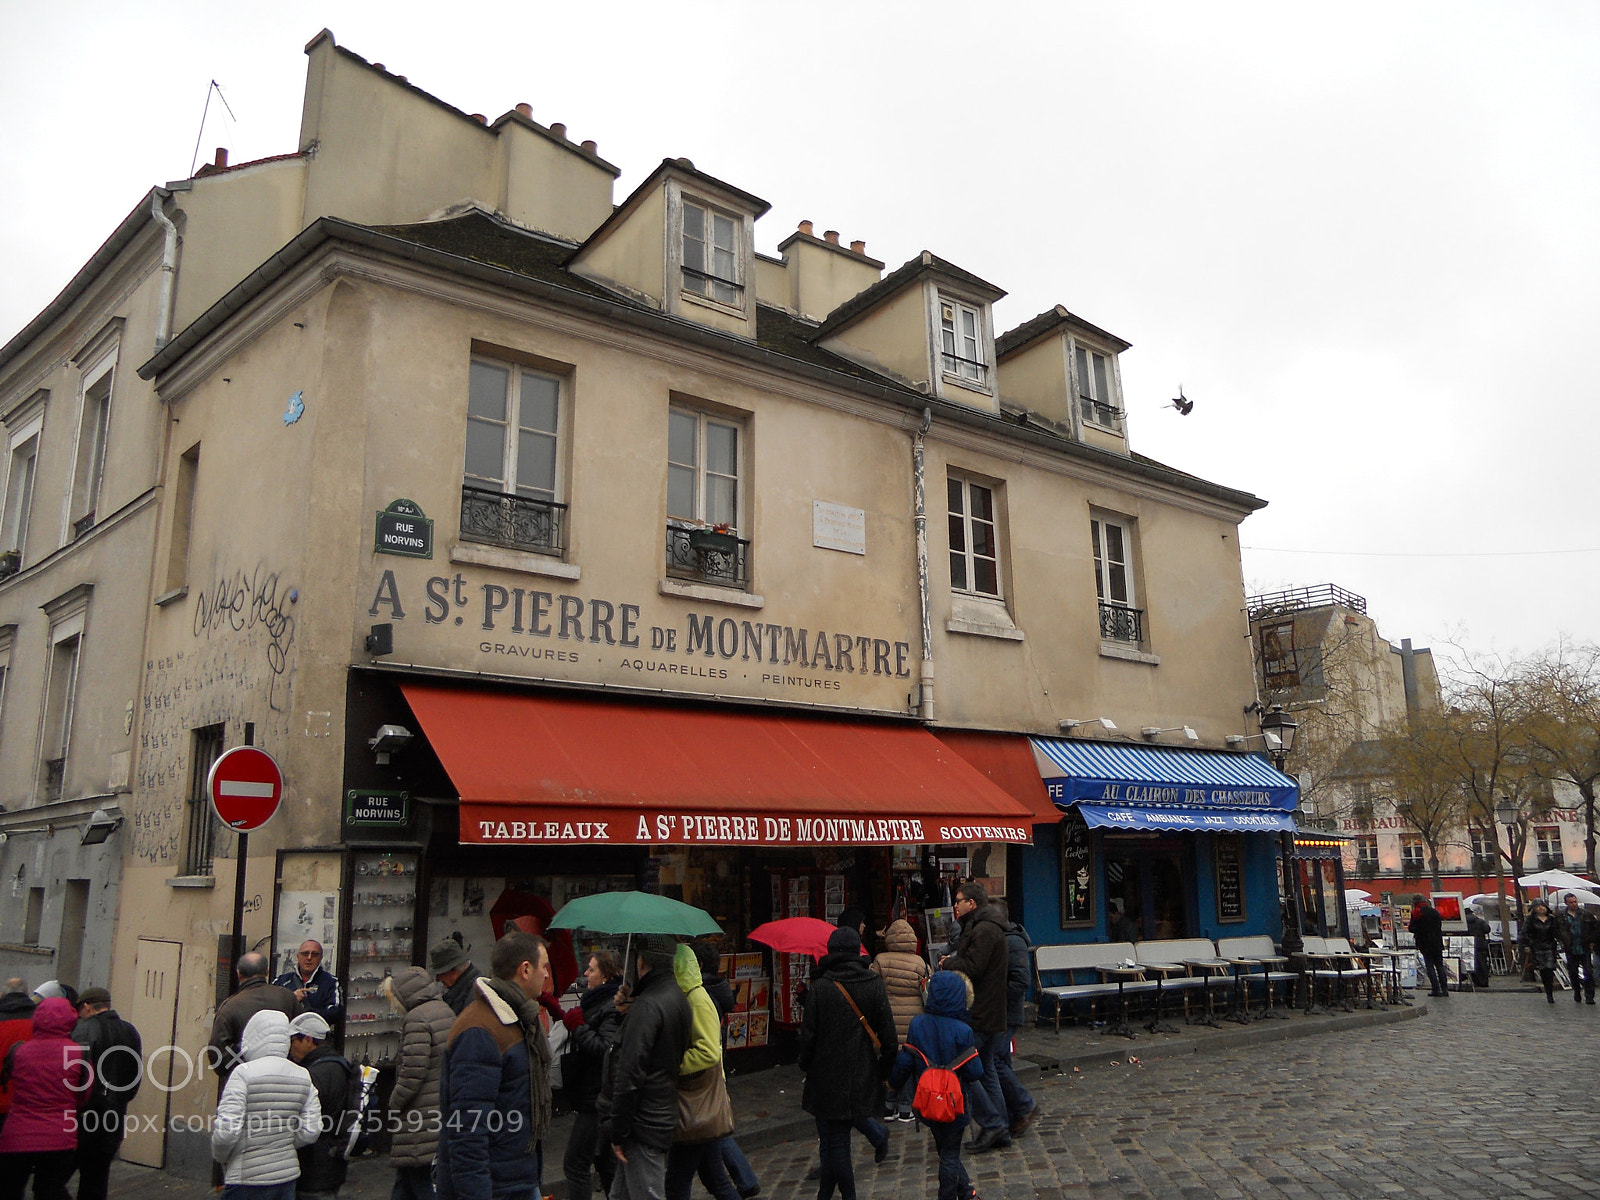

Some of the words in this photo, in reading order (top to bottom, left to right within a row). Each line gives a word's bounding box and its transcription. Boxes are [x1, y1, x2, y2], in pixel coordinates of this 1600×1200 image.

[396, 522, 415, 533] RUE
[384, 534, 424, 548] NORVINS
[368, 569, 406, 620] A
[481, 583, 641, 648] PIERRE
[651, 626, 677, 652] DE
[686, 613, 911, 679] MONTMARTRE
[479, 641, 580, 663] GRAVURES
[620, 658, 728, 679] AQUARELLES
[762, 674, 841, 690] PEINTURES
[368, 797, 389, 807] RUE
[1102, 784, 1120, 799] AU
[1125, 785, 1179, 803] CLAIRON
[1185, 788, 1206, 804] DES
[1211, 790, 1271, 806] CHASSEURS
[355, 808, 400, 819] NORVINS
[1107, 812, 1136, 823] CAFE
[1146, 813, 1194, 824] AMBIANCE
[1203, 815, 1225, 825] JAZZ
[1233, 815, 1279, 826] COCKTAILS
[480, 821, 610, 839] TABLEAUX
[636, 815, 651, 839] A
[681, 815, 759, 841] PIERRE
[764, 817, 791, 841] DE
[796, 818, 925, 842] MONTMARTRE
[940, 826, 1027, 841] SOUVENIRS
